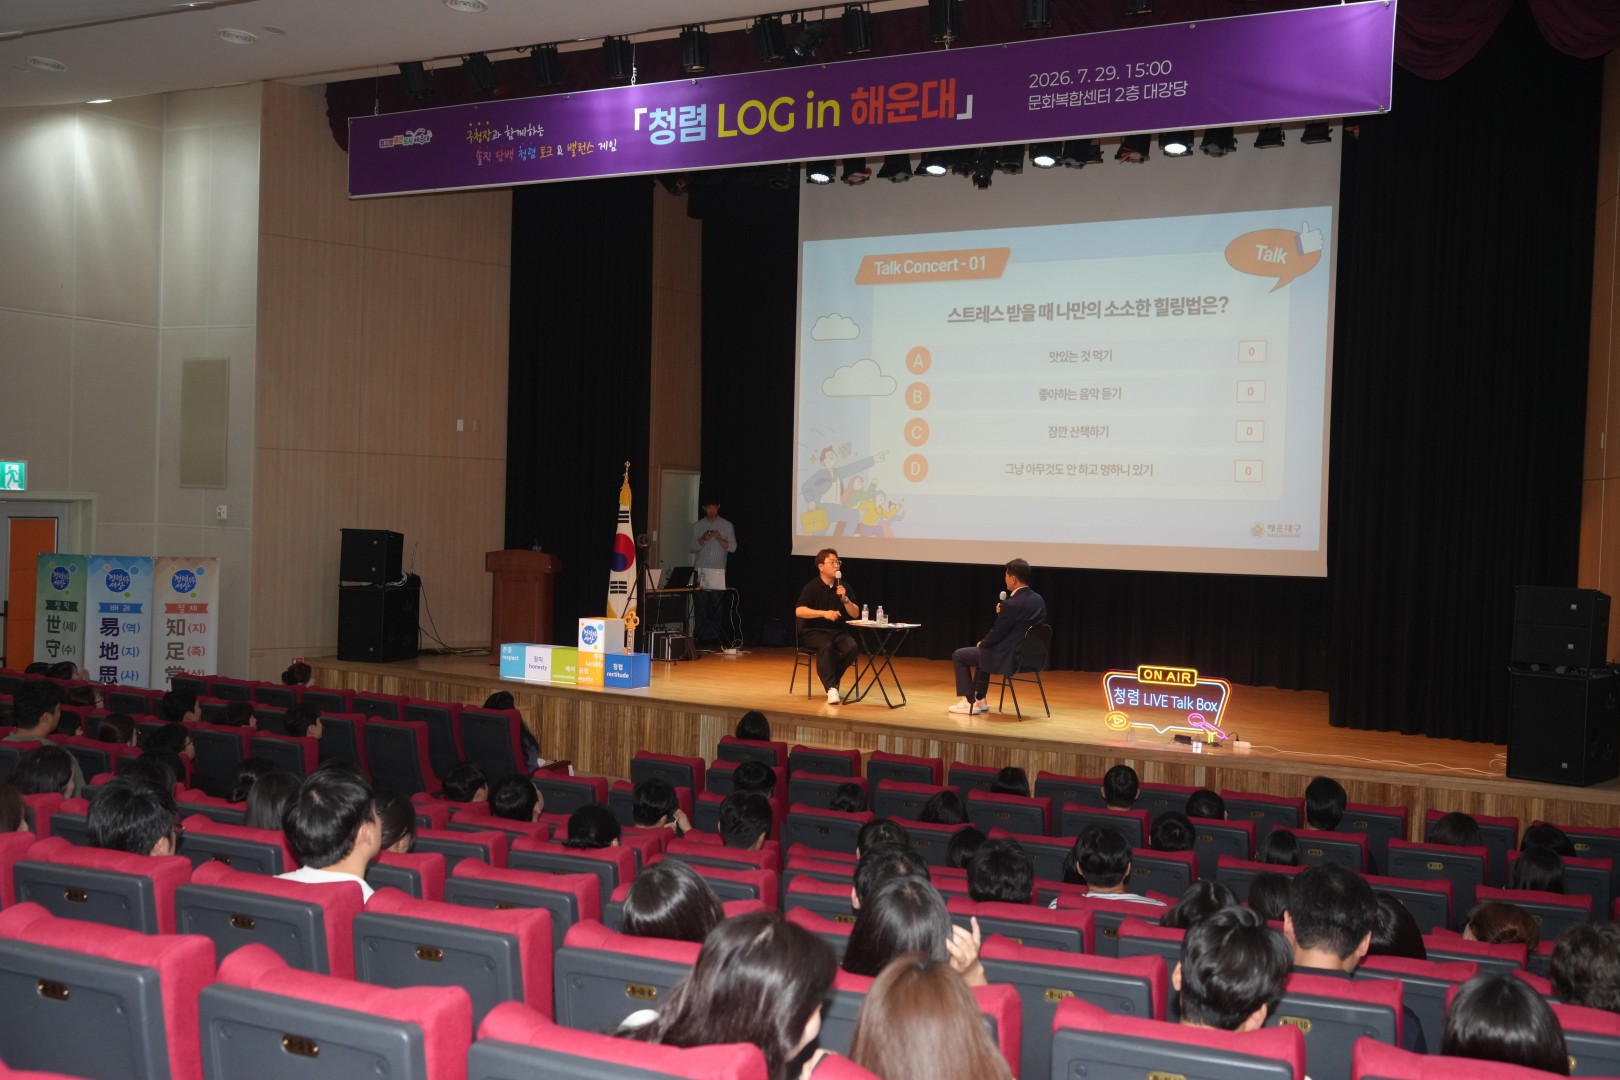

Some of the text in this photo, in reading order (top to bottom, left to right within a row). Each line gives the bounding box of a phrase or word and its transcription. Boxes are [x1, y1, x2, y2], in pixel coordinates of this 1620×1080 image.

[1028, 60, 1172, 88] 2026. 7. 29. 15:00
[1028, 80, 1188, 110] 문화복합센터 2층 대강당
[717, 96, 796, 138] LOG
[806, 90, 841, 129] in
[465, 123, 545, 144] 구청장과 함께하는
[495, 147, 514, 162] 담백
[517, 145, 537, 161] 청렴
[539, 146, 553, 158] 토크
[557, 144, 564, 156] &
[567, 140, 595, 157] 밸런스
[597, 138, 617, 152] 게임
[1255, 244, 1288, 265] Talk
[874, 261, 901, 276] Talk
[903, 257, 959, 274] Concert
[969, 255, 986, 271] 01
[947, 296, 1230, 324] 스트레스 받을 때 나만의 소소한 힐링법은?
[1049, 349, 1113, 364] 맛있는 것 먹기
[1248, 346, 1255, 357] 0
[912, 353, 924, 369] A
[912, 389, 922, 404] B
[1039, 387, 1122, 401] 좋아하는 음악 듣기
[1247, 386, 1254, 397] 0
[911, 425, 922, 440] C
[1048, 425, 1110, 439] 잠깐 산책하기
[1246, 426, 1253, 436] 0
[911, 461, 921, 476] D
[1005, 463, 1154, 477] 그냥 아무것도 안 하고 멍하니 있기
[1245, 466, 1252, 476] 0
[528, 663, 547, 671] honesty
[606, 671, 629, 679] rectitude
[1143, 669, 1191, 683] ON AIR
[1113, 686, 1218, 712] 청렴 LIVE Talk Box
